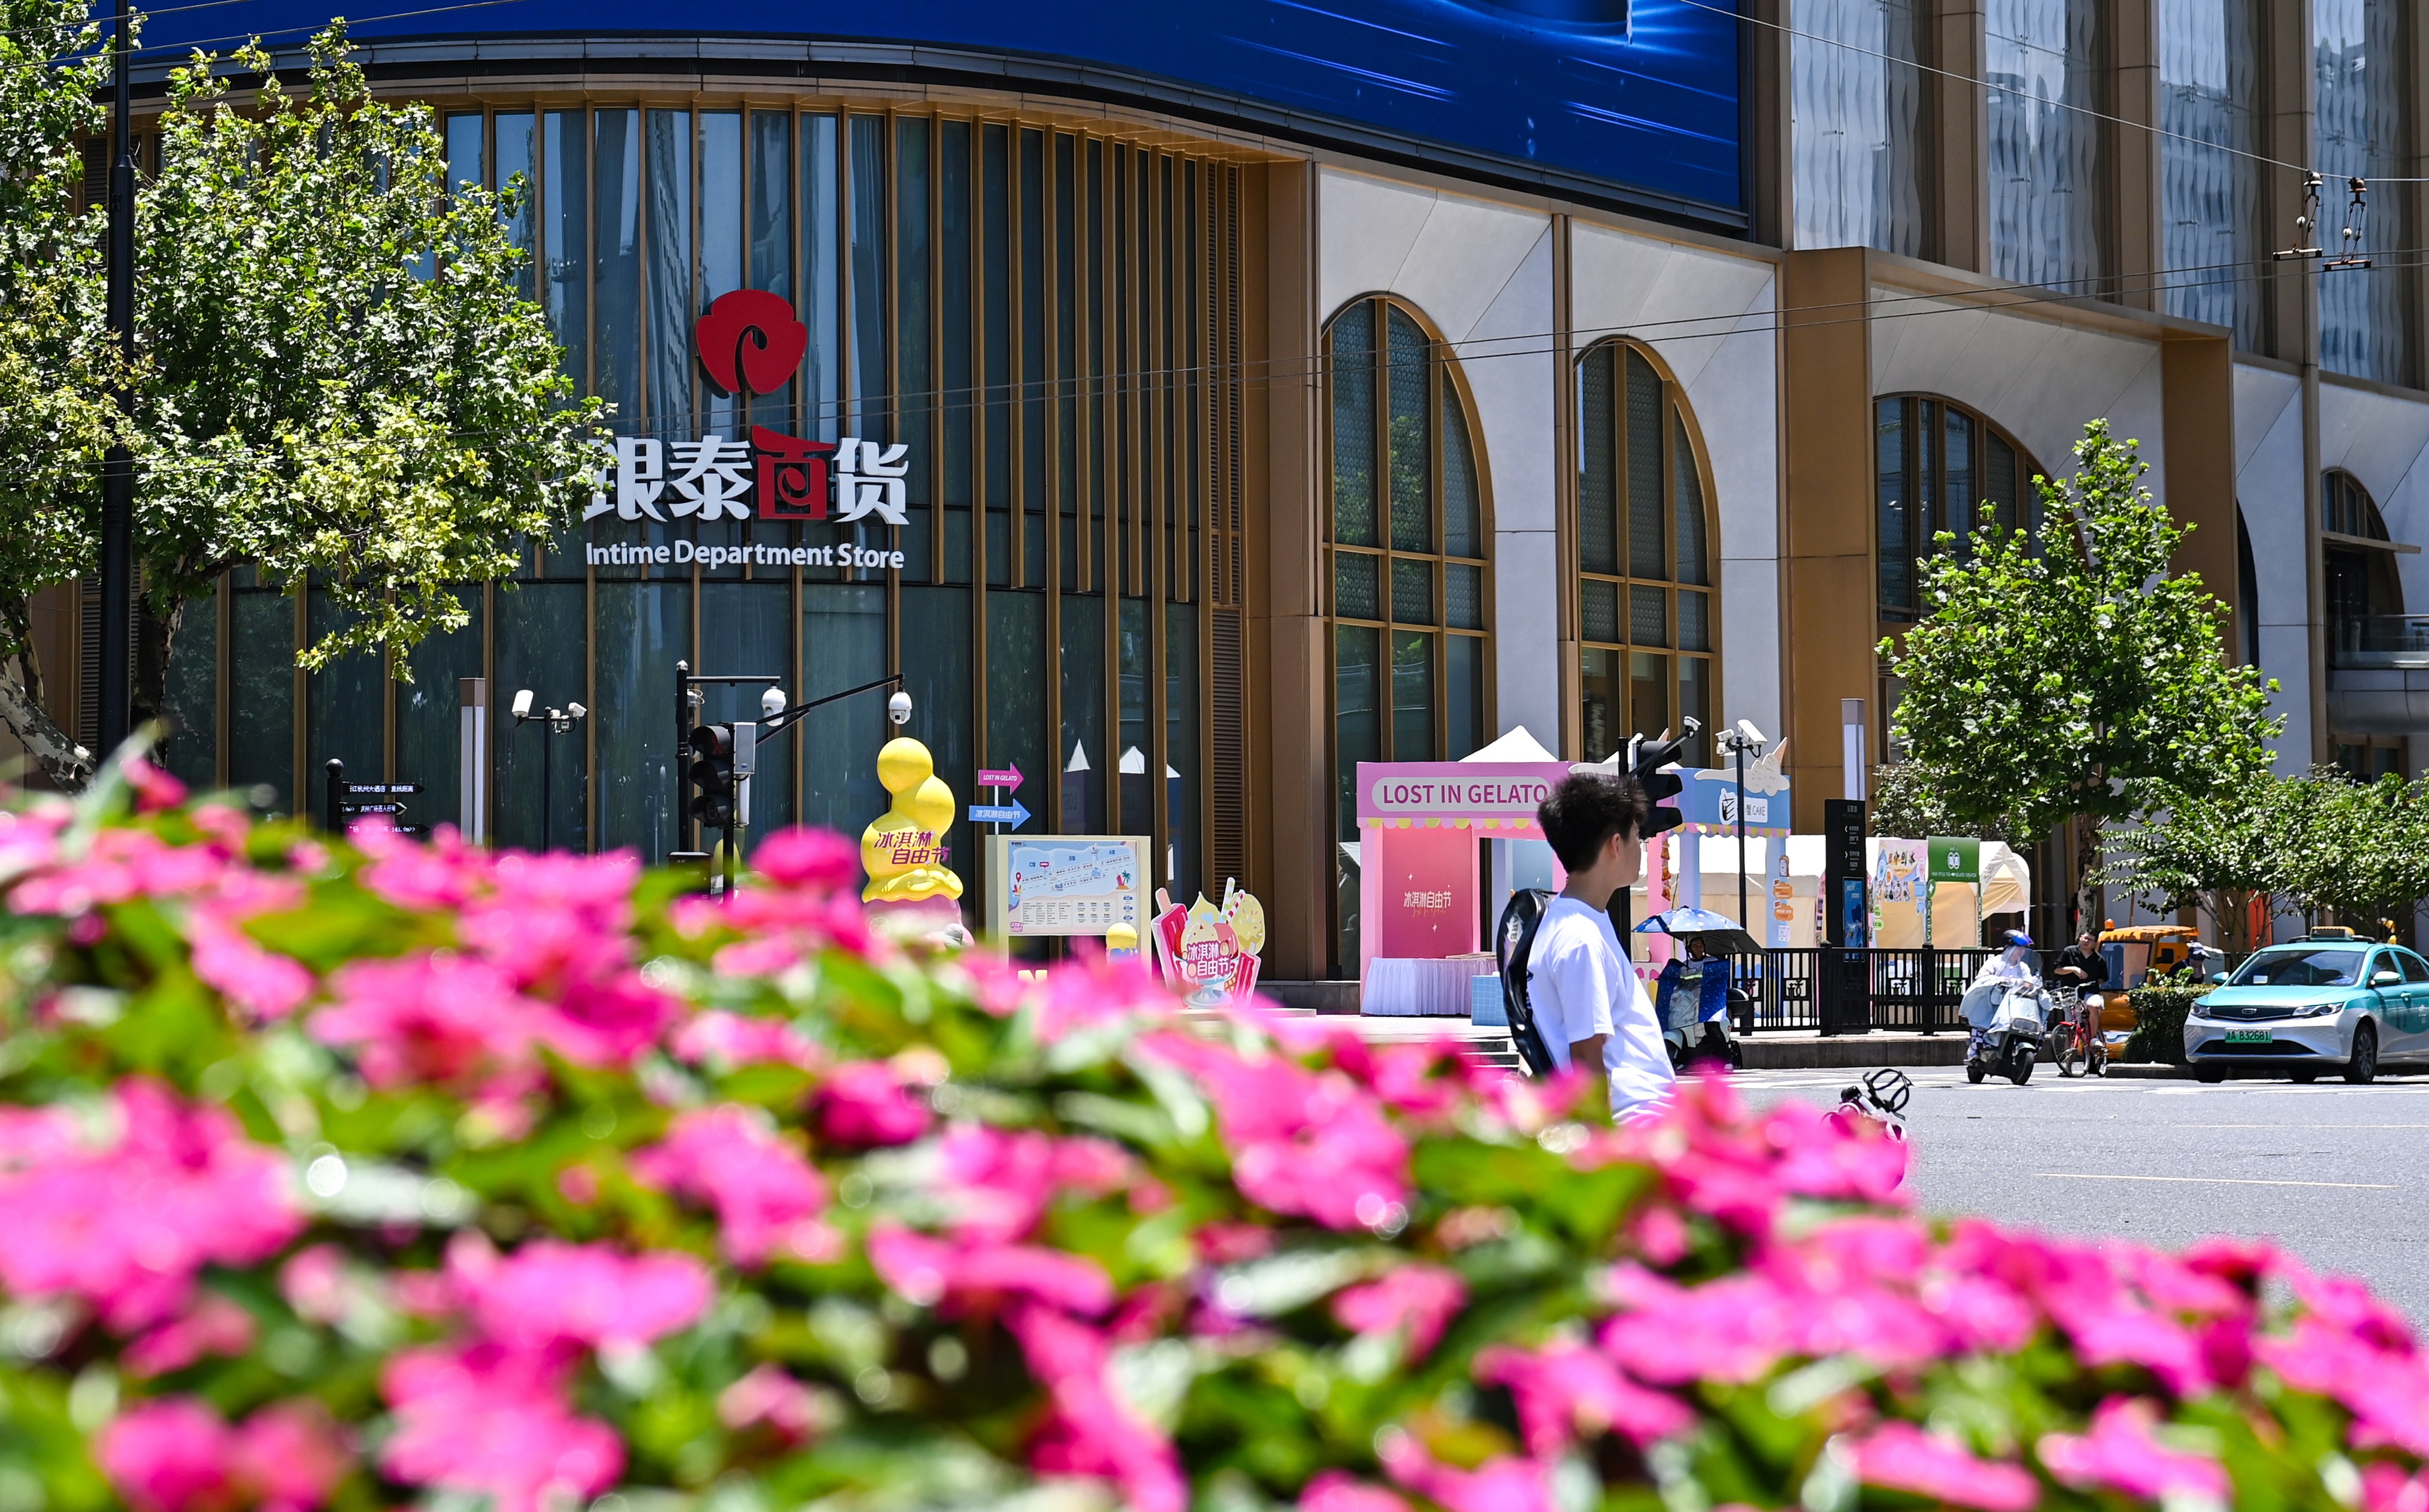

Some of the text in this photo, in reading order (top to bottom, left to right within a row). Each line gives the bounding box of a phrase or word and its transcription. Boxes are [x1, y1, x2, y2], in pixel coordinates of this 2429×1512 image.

[581, 425, 910, 525] 银泰百货
[586, 540, 905, 570] Intime Department Store
[1383, 784, 1549, 804] LOST IN GELATO
[974, 809, 1021, 819] 冰淇淋自由节
[1752, 805, 1765, 816] CAKE
[873, 831, 932, 849] 冰淇淋
[891, 846, 951, 865] 自由节
[1403, 890, 1452, 909] 冰淇淋自由节
[1187, 941, 1219, 962] 冰淇淋
[1197, 956, 1229, 977] 自由节
